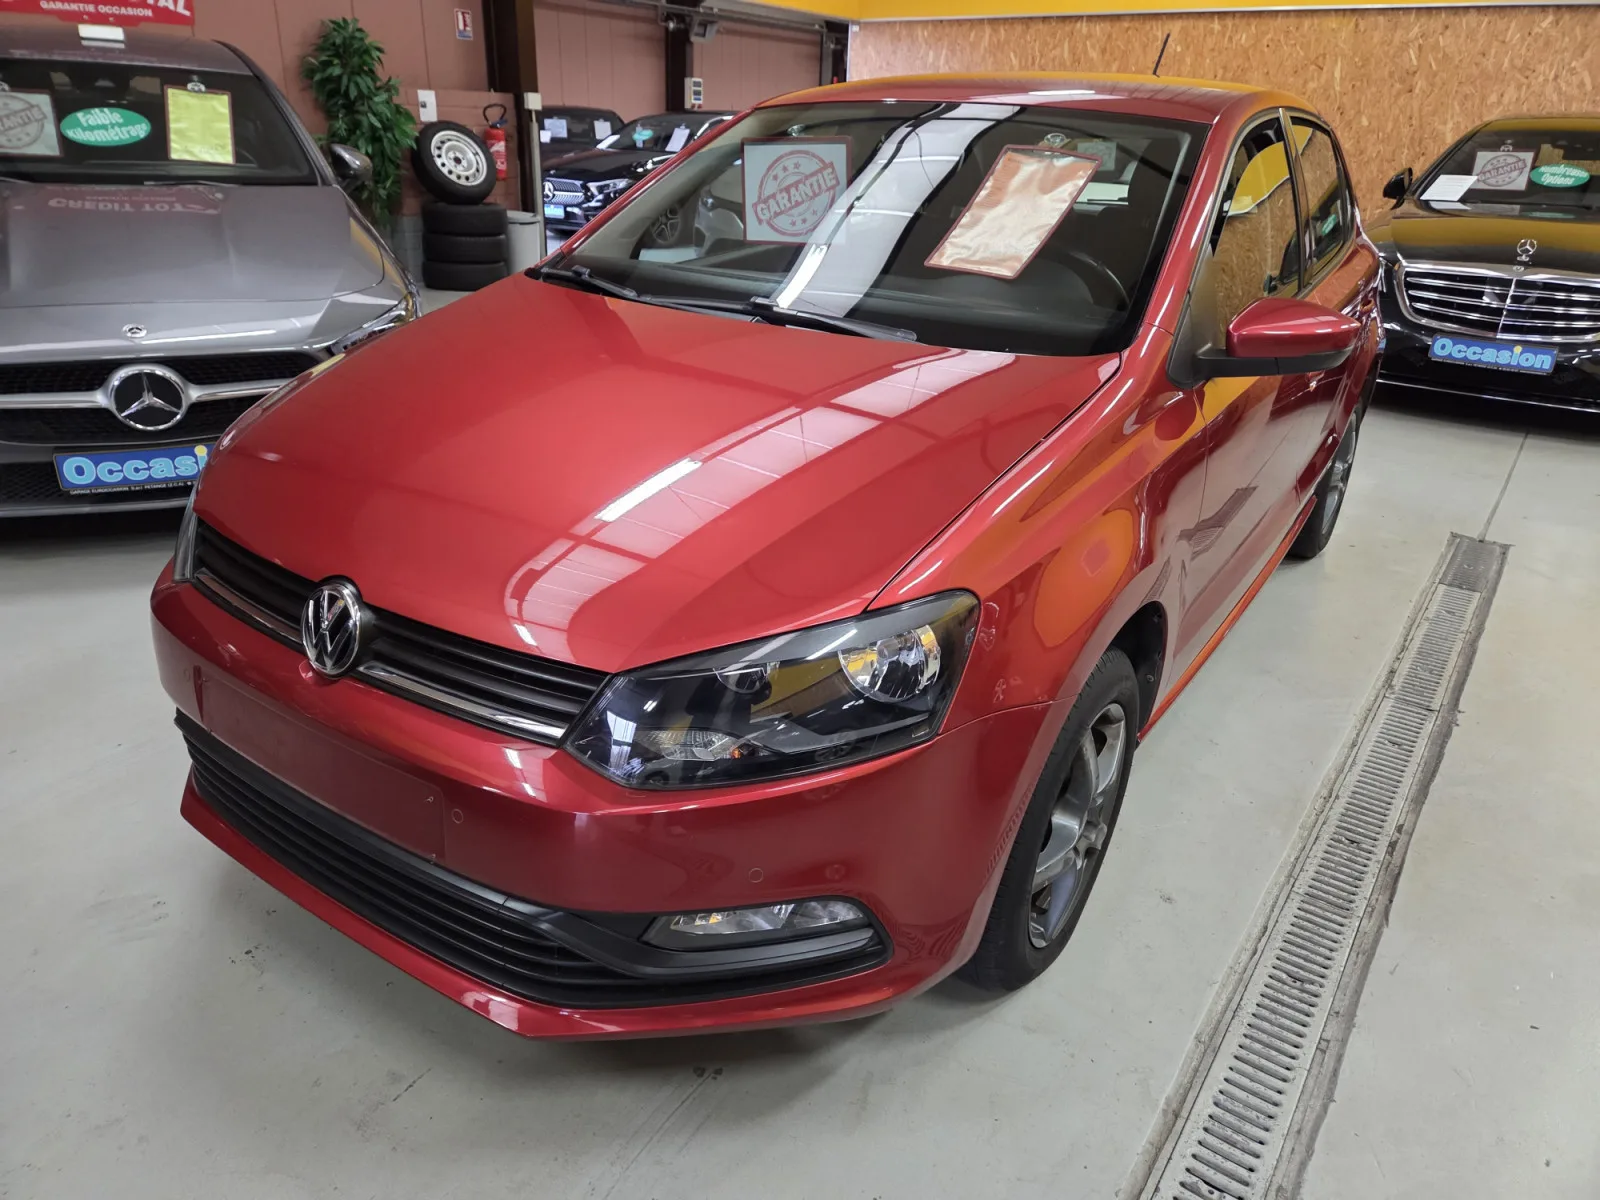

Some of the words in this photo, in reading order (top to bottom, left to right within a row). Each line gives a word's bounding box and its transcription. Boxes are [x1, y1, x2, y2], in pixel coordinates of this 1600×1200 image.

[40, 1, 95, 13] GARANTIE
[98, 4, 152, 17] OCCASION
[76, 108, 123, 127] Faible
[1479, 160, 1525, 181] GARANTIE
[1541, 173, 1575, 185] Options
[757, 166, 837, 221] GARANTIE
[1433, 338, 1552, 369] Occasion
[62, 445, 208, 485] Occasi
